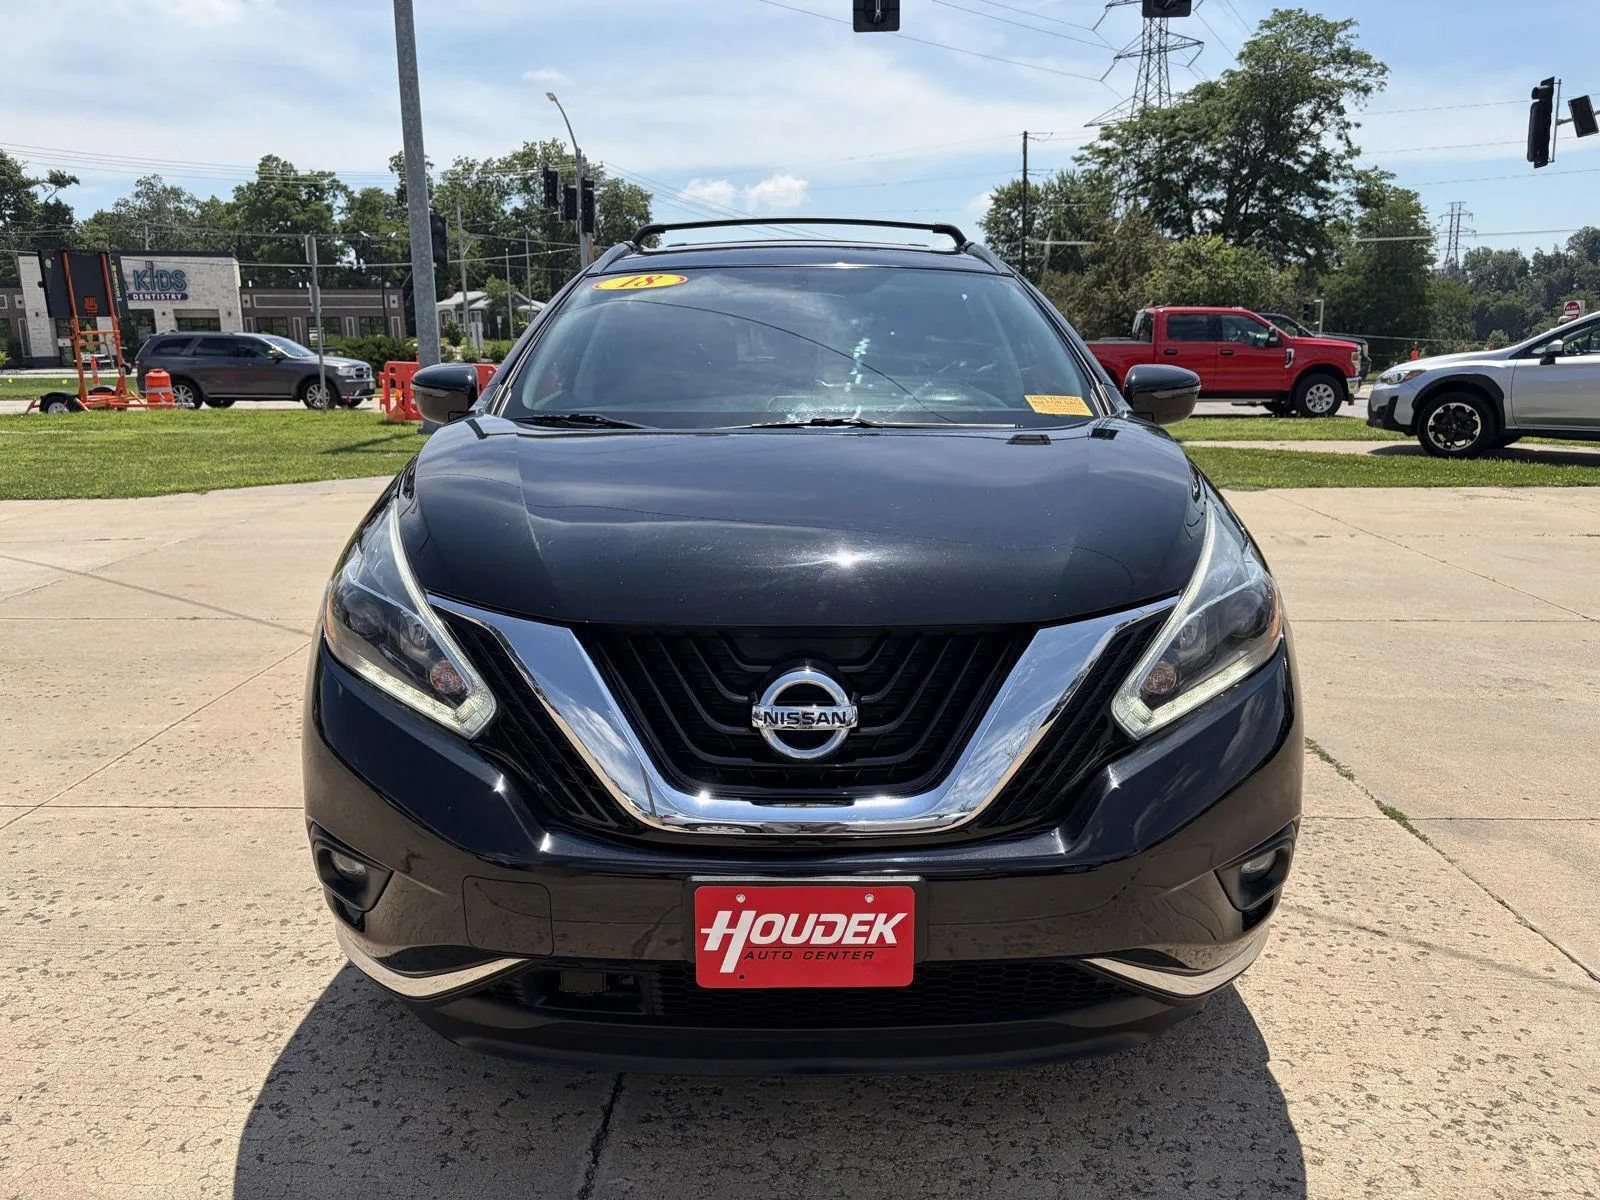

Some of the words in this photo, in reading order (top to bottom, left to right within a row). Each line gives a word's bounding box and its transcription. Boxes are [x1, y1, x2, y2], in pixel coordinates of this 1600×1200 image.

[133, 261, 187, 291] KIDS
[763, 711, 846, 725] NISSAN
[700, 910, 908, 973] HOUDEK
[743, 950, 793, 960] AUTO
[802, 950, 875, 960] CENTER
